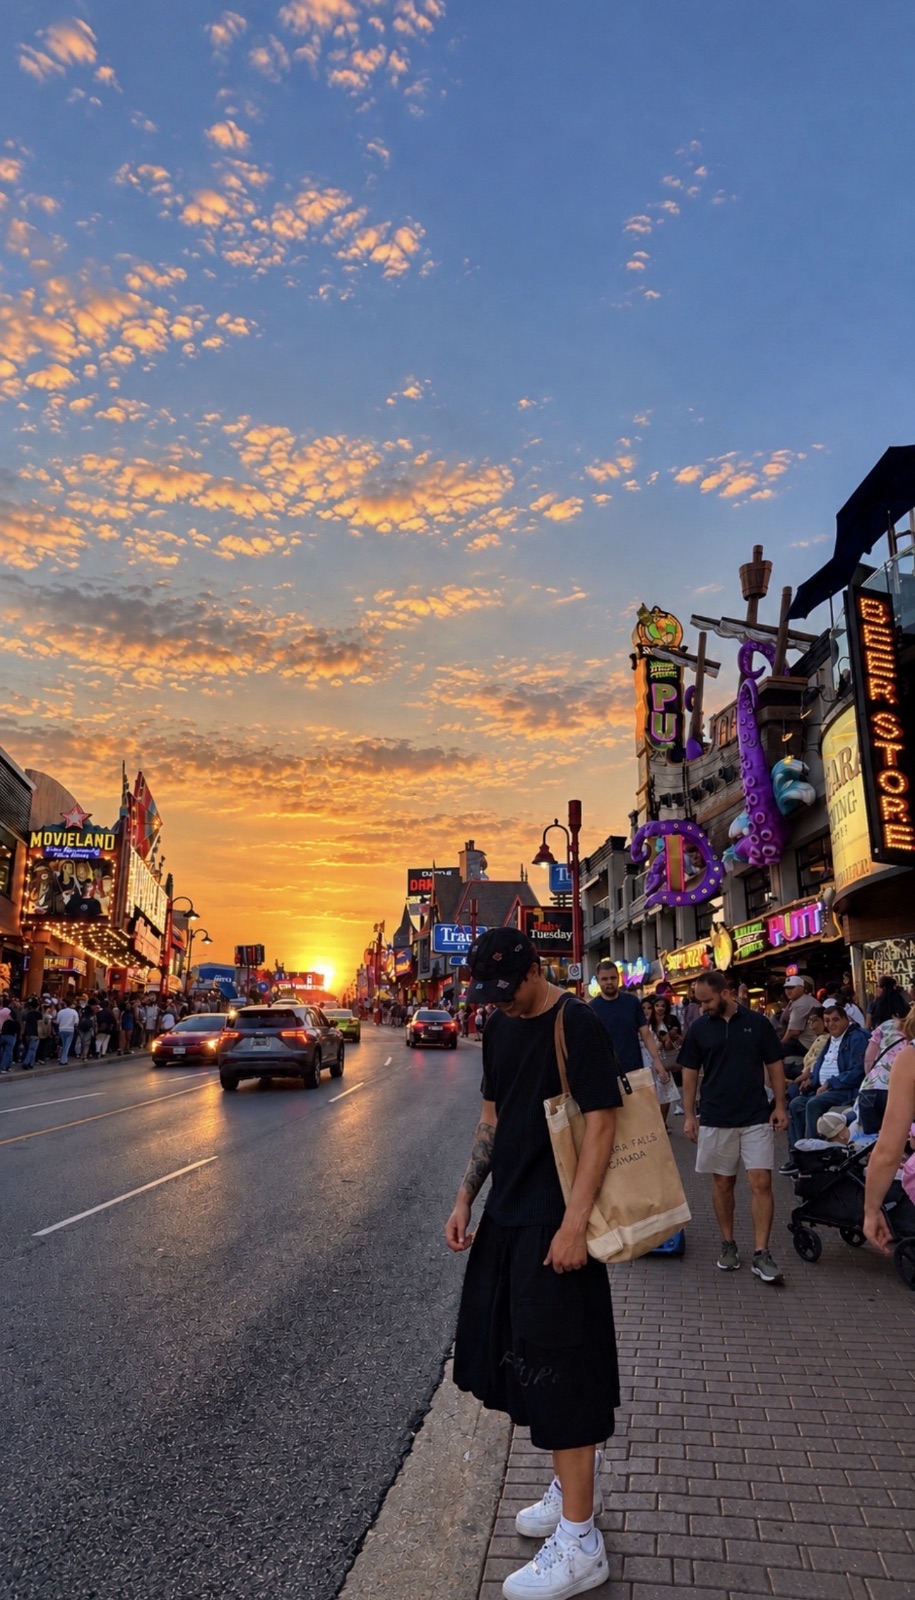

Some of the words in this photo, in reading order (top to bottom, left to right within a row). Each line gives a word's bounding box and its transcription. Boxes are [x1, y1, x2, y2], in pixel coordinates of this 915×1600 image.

[859, 596, 897, 704] BEER
[870, 710, 914, 852] STORE
[30, 831, 116, 851] MOVIELAND
[767, 901, 823, 947] PUTT
[530, 929, 573, 941] Tuesday
[631, 1132, 658, 1146] FALLS
[607, 1150, 647, 1170] CANADA
